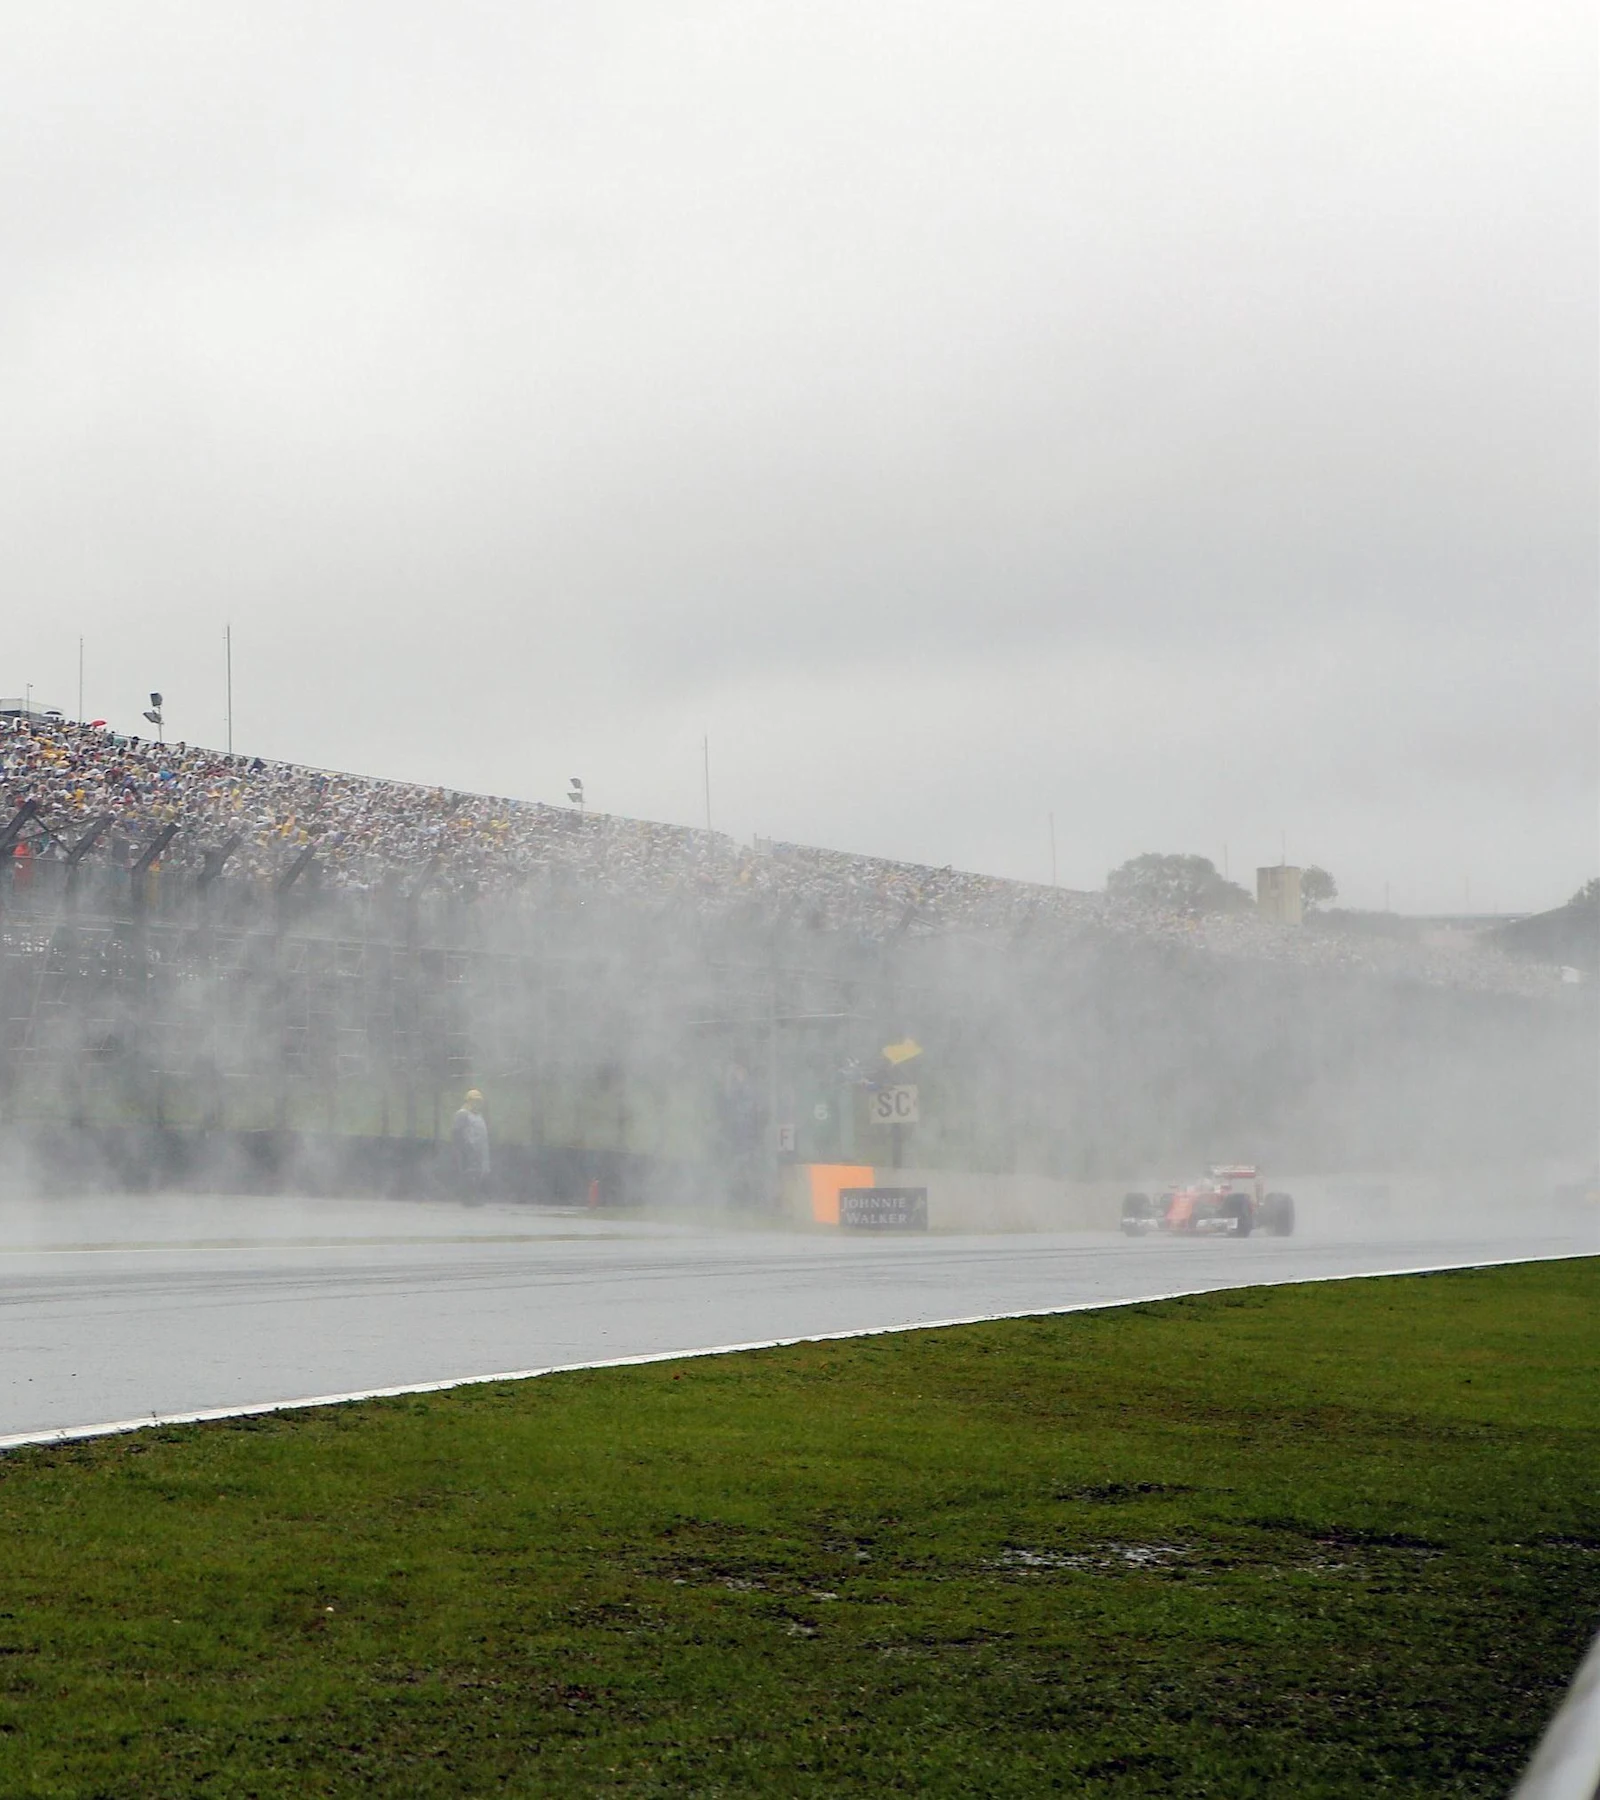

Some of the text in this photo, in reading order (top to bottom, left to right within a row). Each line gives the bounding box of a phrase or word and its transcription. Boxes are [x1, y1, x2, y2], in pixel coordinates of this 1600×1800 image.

[877, 1090, 911, 1118] SC
[841, 1197, 907, 1212] JOHNNIE
[845, 1213, 908, 1224] WALKER
